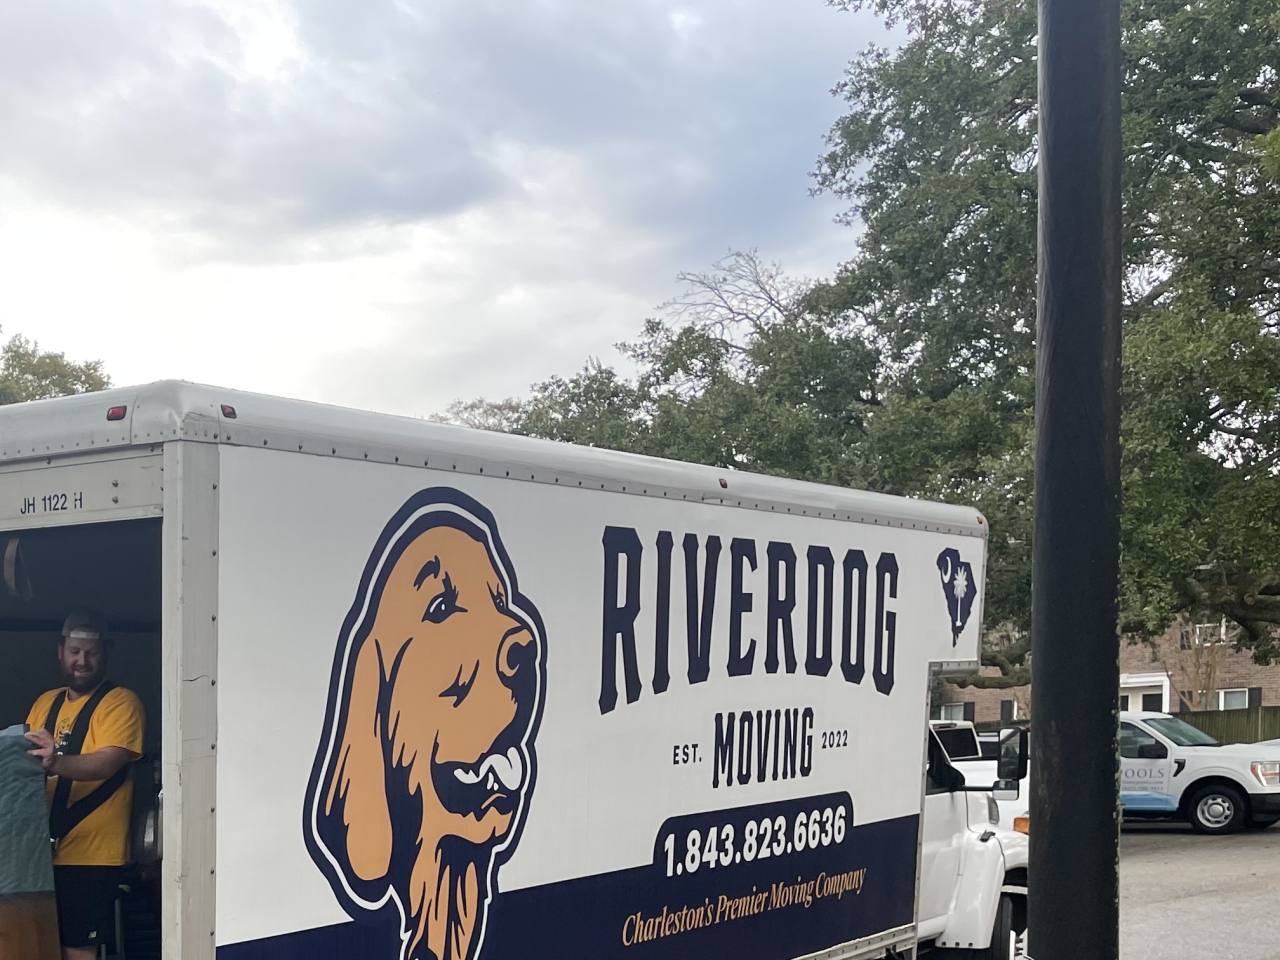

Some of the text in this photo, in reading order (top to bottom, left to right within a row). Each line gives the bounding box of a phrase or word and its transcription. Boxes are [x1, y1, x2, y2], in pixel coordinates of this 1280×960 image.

[20, 491, 83, 514] JH 1122 H
[598, 525, 899, 716] RIVERDOG
[673, 707, 848, 788] EST. MOVING 2022
[664, 805, 846, 877] 1.843.823.6636
[622, 867, 867, 946] Charleston's Premier Moving Company
